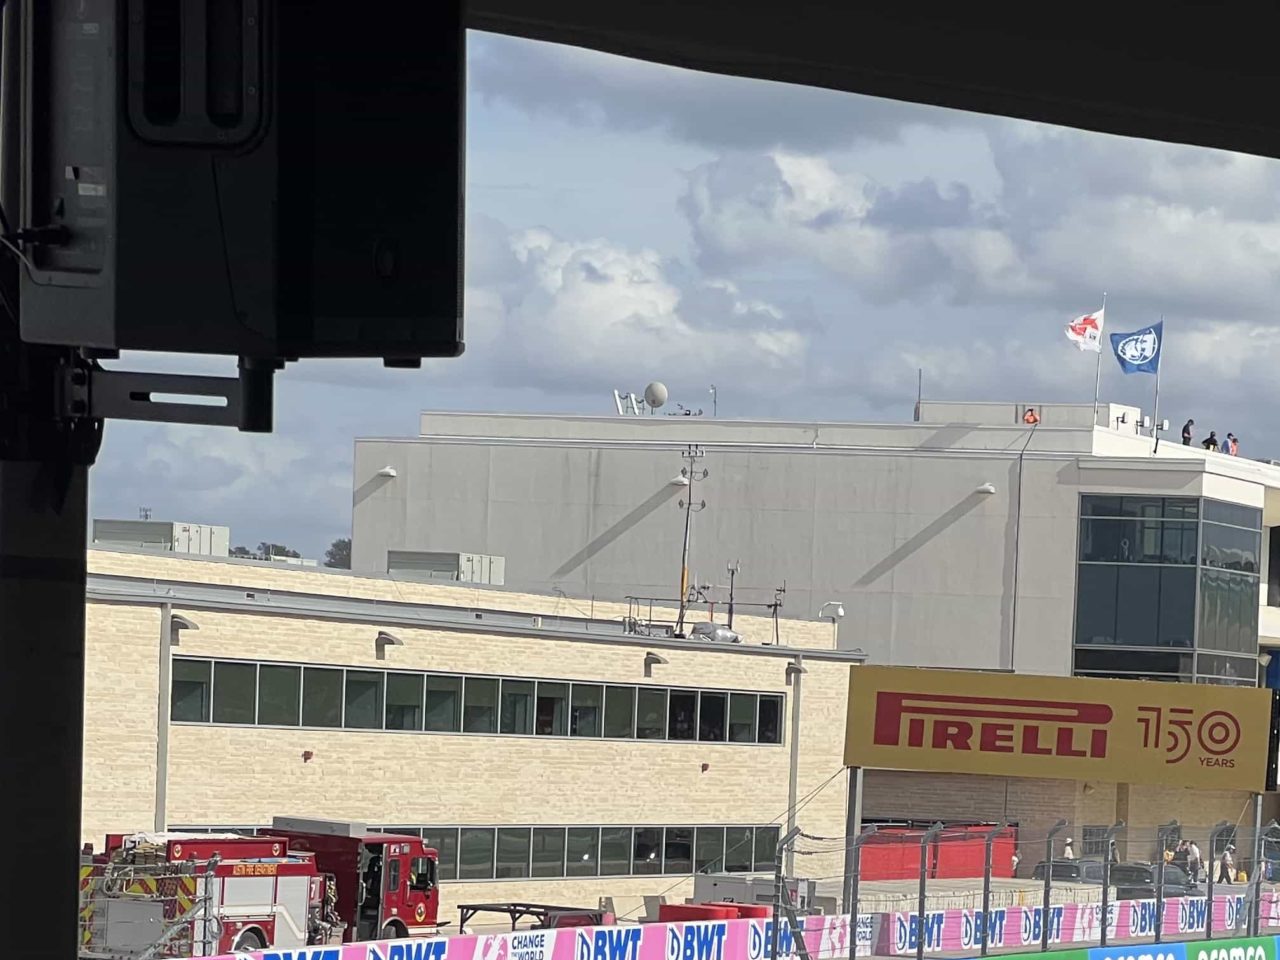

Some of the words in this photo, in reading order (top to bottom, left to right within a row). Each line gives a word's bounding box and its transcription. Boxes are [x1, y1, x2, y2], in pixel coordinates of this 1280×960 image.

[874, 691, 1113, 758] PIRELLI
[1137, 706, 1241, 764] 150
[1199, 757, 1235, 768] YEARS
[512, 934, 545, 950] CHANGE
